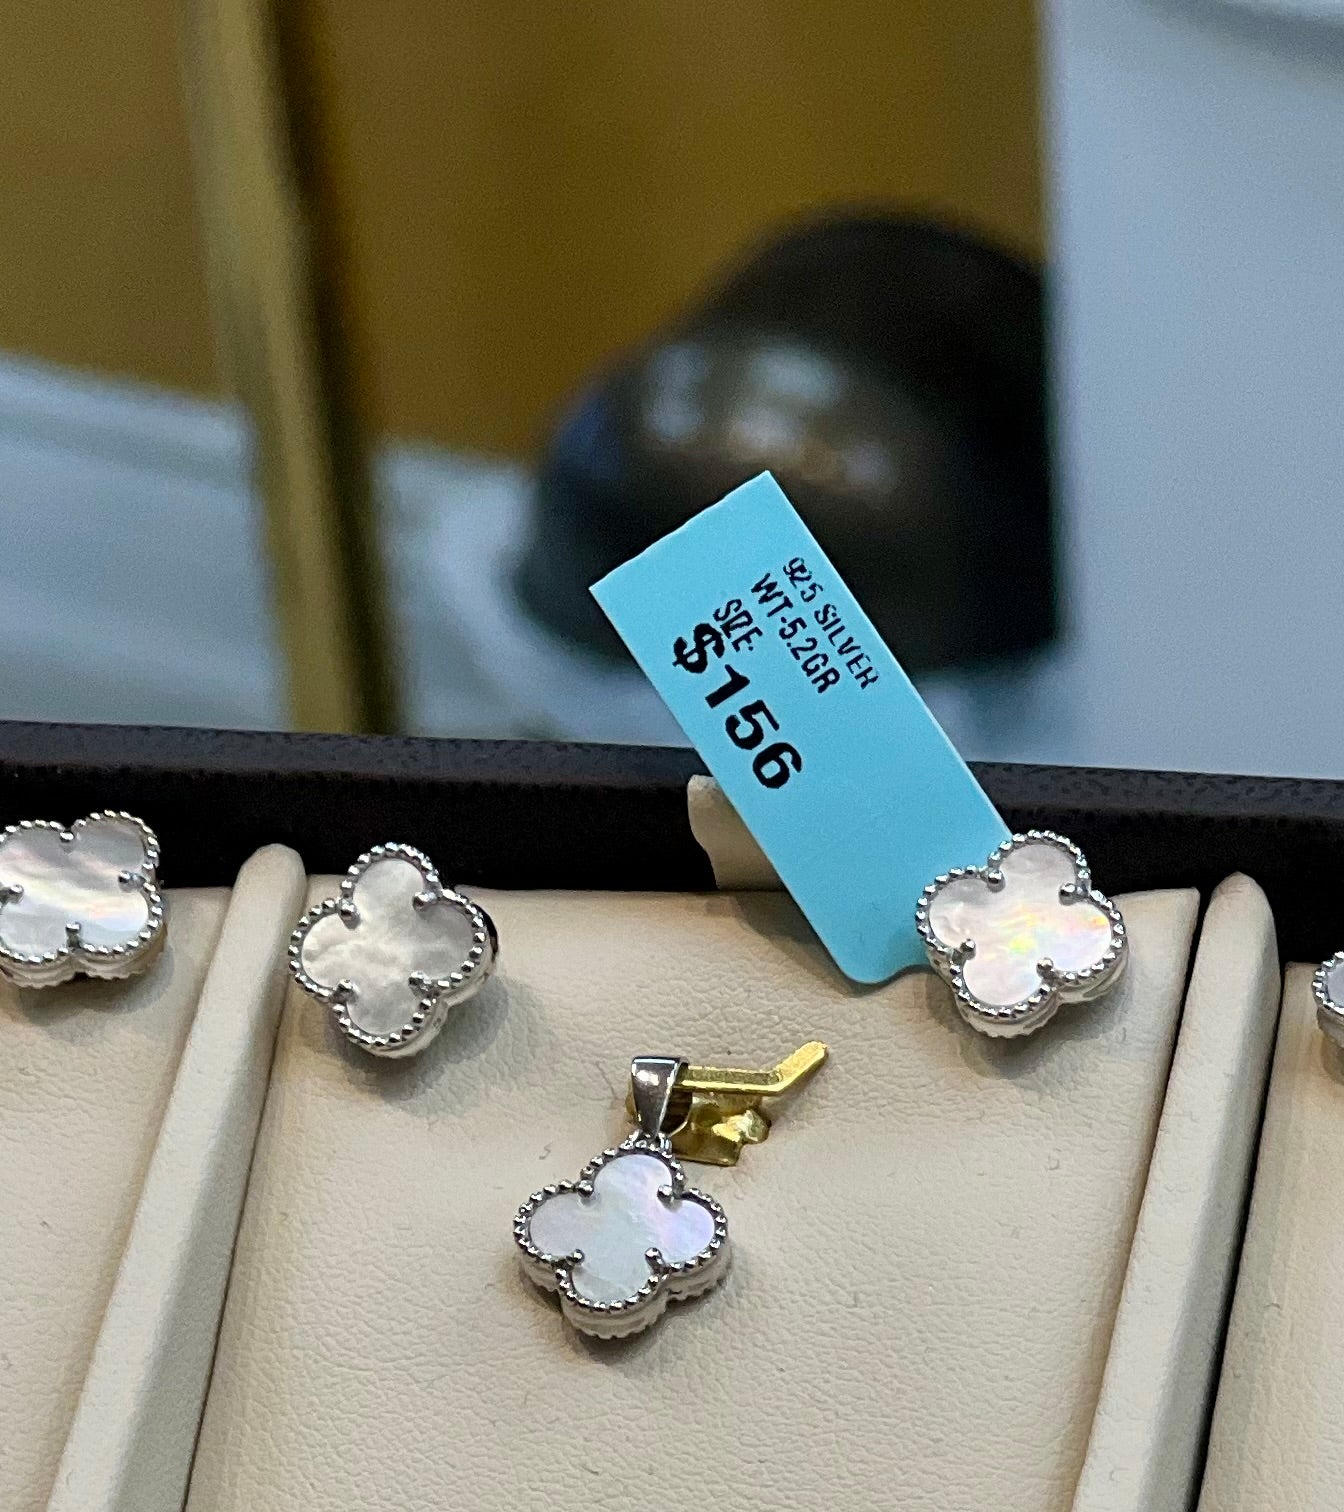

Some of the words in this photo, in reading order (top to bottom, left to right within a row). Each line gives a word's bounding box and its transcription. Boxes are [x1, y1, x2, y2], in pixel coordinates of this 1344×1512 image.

[783, 556, 824, 603] 925
[813, 602, 880, 690] SILVER
[672, 623, 803, 789] $156
